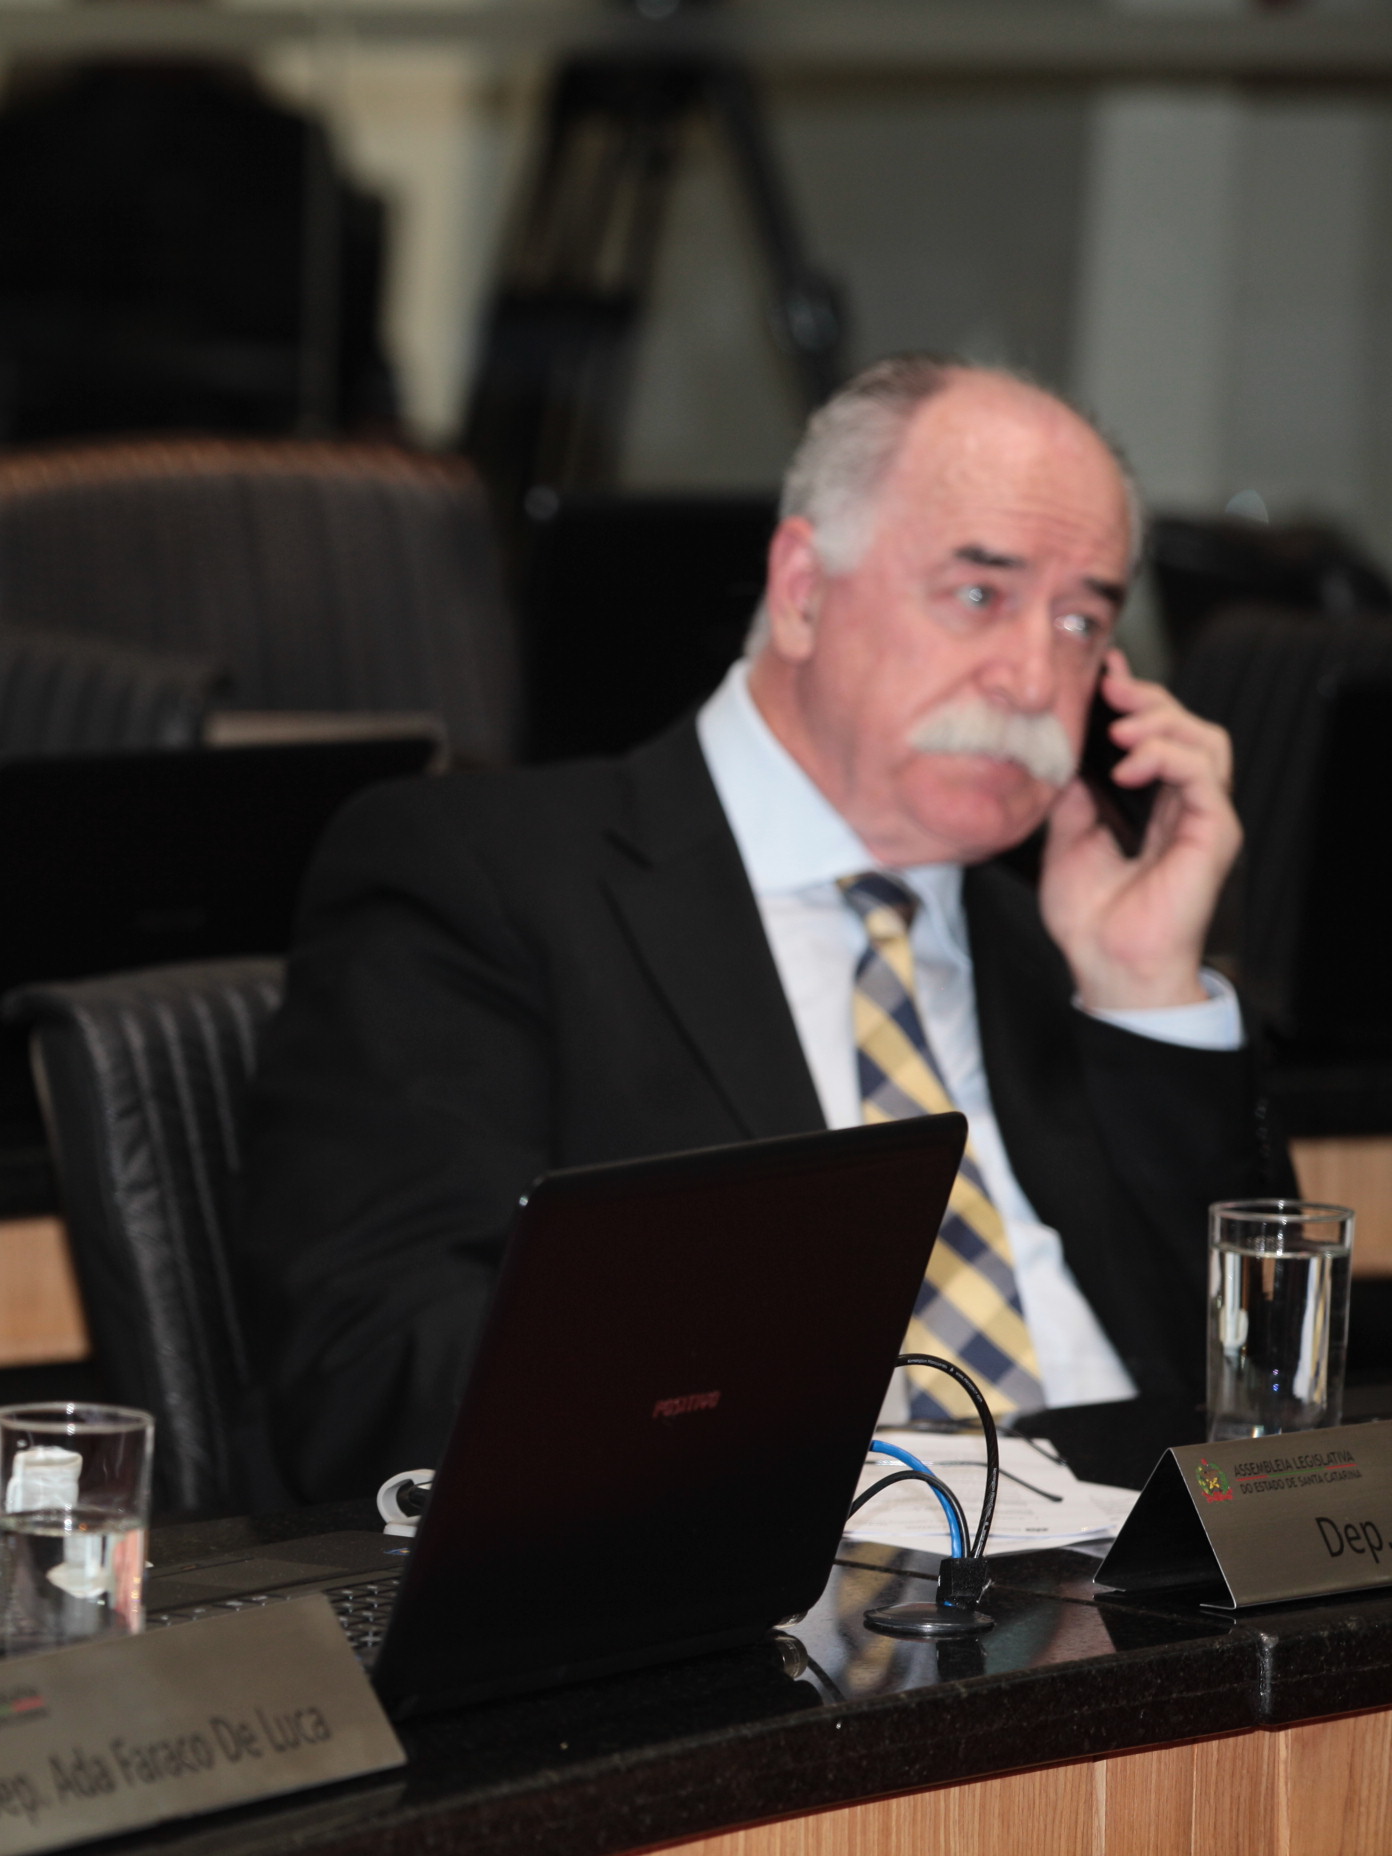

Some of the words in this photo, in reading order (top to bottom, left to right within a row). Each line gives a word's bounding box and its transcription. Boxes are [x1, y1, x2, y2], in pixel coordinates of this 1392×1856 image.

[1234, 1459, 1291, 1477] ASSEMBLEIA
[1293, 1450, 1355, 1469] LEGISLATIVA
[1239, 1482, 1254, 1494] DO
[1255, 1479, 1285, 1493] ESTADO
[1286, 1477, 1298, 1488] DE
[1298, 1473, 1323, 1487] SANTA
[1323, 1469, 1362, 1483] CATARINA
[48, 1746, 115, 1801] Ada
[112, 1730, 214, 1787] Faraco
[210, 1715, 262, 1763] De
[256, 1706, 331, 1753] Luca
